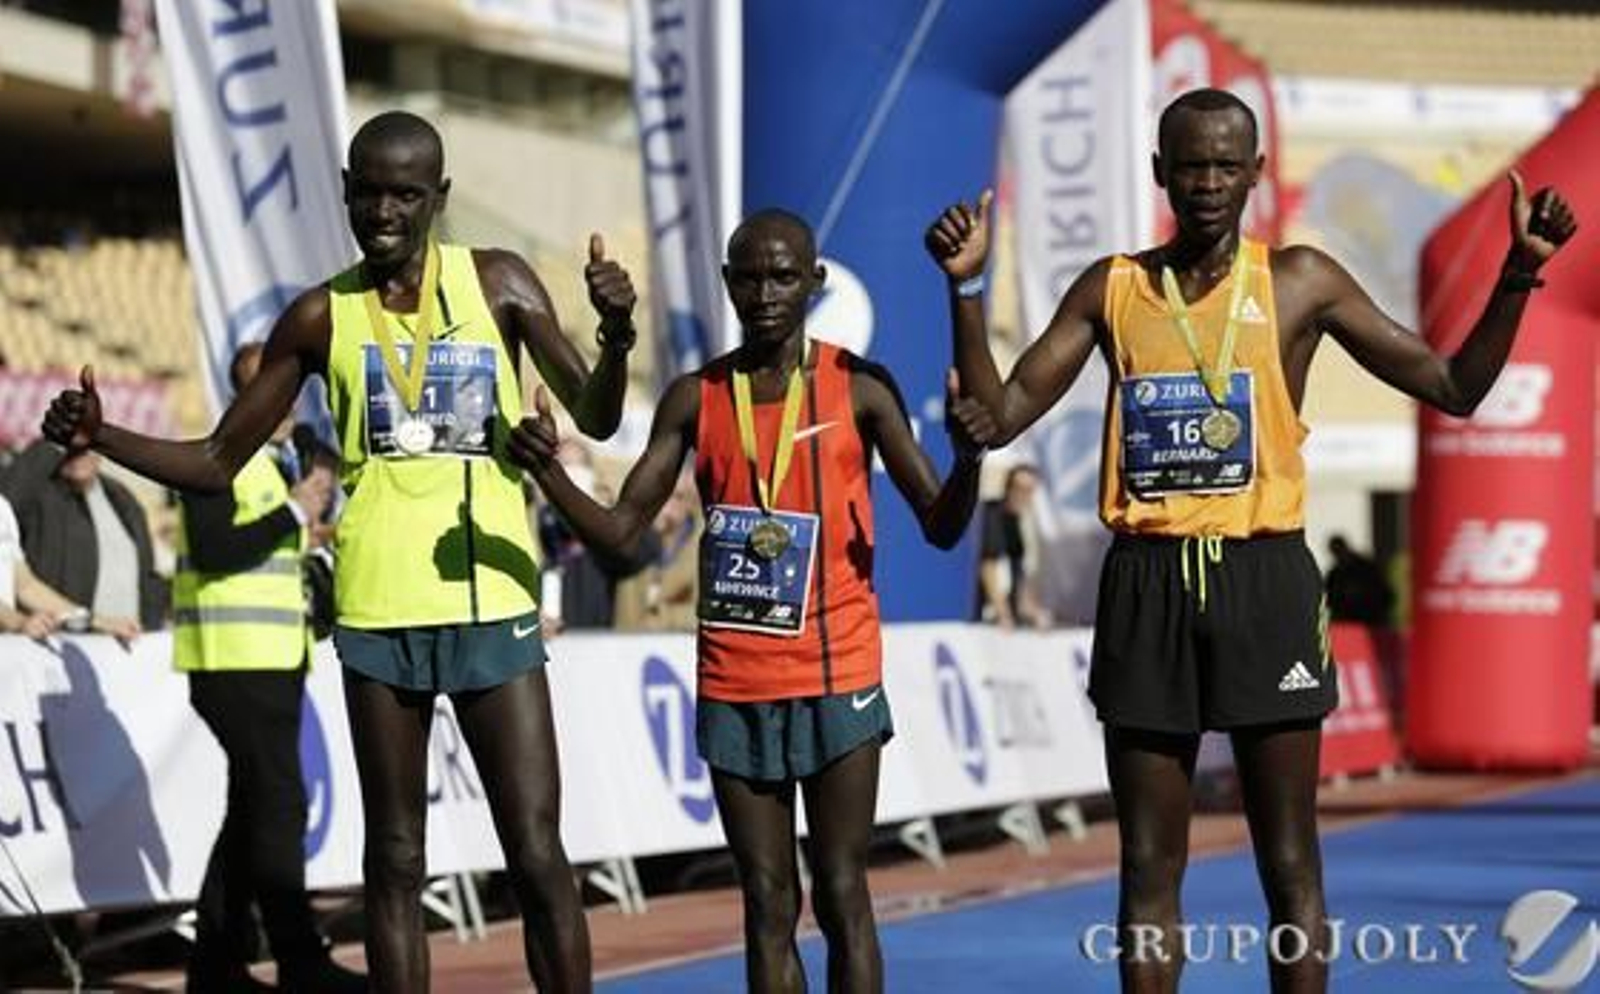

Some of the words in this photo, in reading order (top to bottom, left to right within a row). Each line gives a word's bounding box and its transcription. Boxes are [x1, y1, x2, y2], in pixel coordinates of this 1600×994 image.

[423, 386, 438, 410] 1
[1166, 419, 1201, 445] 16
[727, 552, 761, 581] 25
